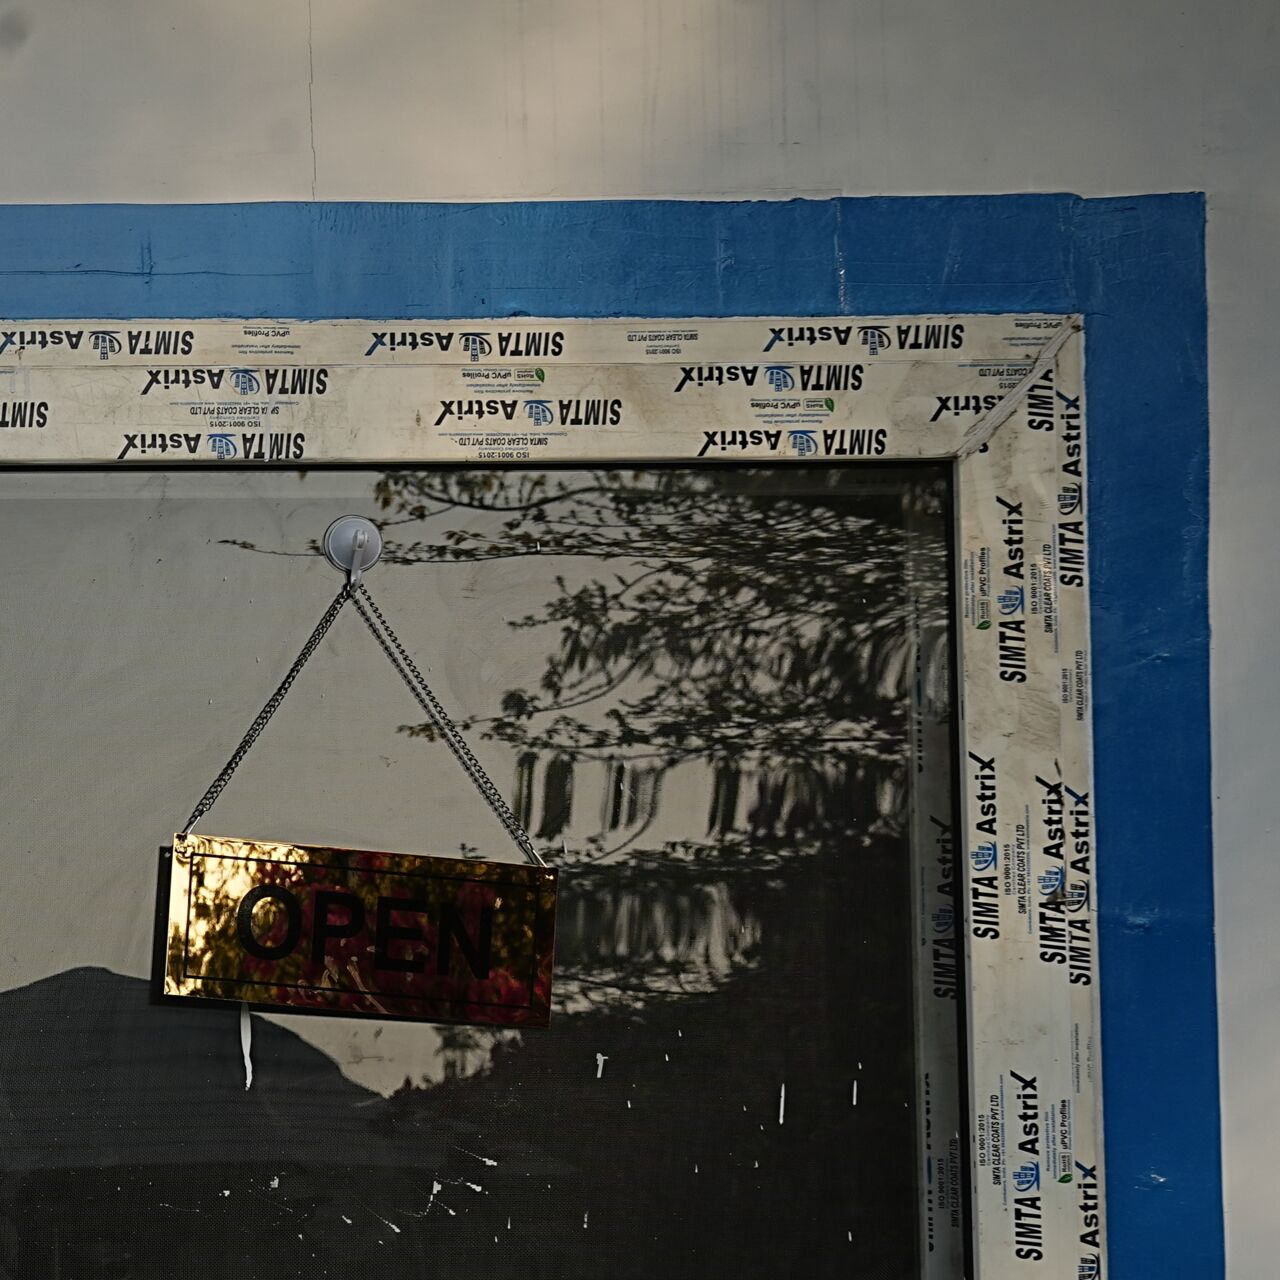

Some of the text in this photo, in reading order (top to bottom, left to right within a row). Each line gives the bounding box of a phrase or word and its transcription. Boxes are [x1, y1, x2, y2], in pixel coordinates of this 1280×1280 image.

[127, 330, 193, 356] SIMTA
[498, 332, 564, 356] SIMTA
[897, 324, 964, 349] SIMTA
[265, 369, 328, 394] SIMTA
[800, 365, 863, 391] SIMTA
[559, 399, 622, 425] SIMTA
[242, 433, 305, 459] SIMTA
[823, 429, 886, 455] SIMTA
[1059, 521, 1084, 587] SIMTA
[999, 620, 1026, 683] SIMTA
[971, 876, 999, 939] SIMTA
[239, 885, 494, 981] OPEN
[1038, 900, 1068, 966] SIMTA
[1068, 920, 1091, 985] SIMTA
[1014, 1197, 1043, 1260] SIMTA
